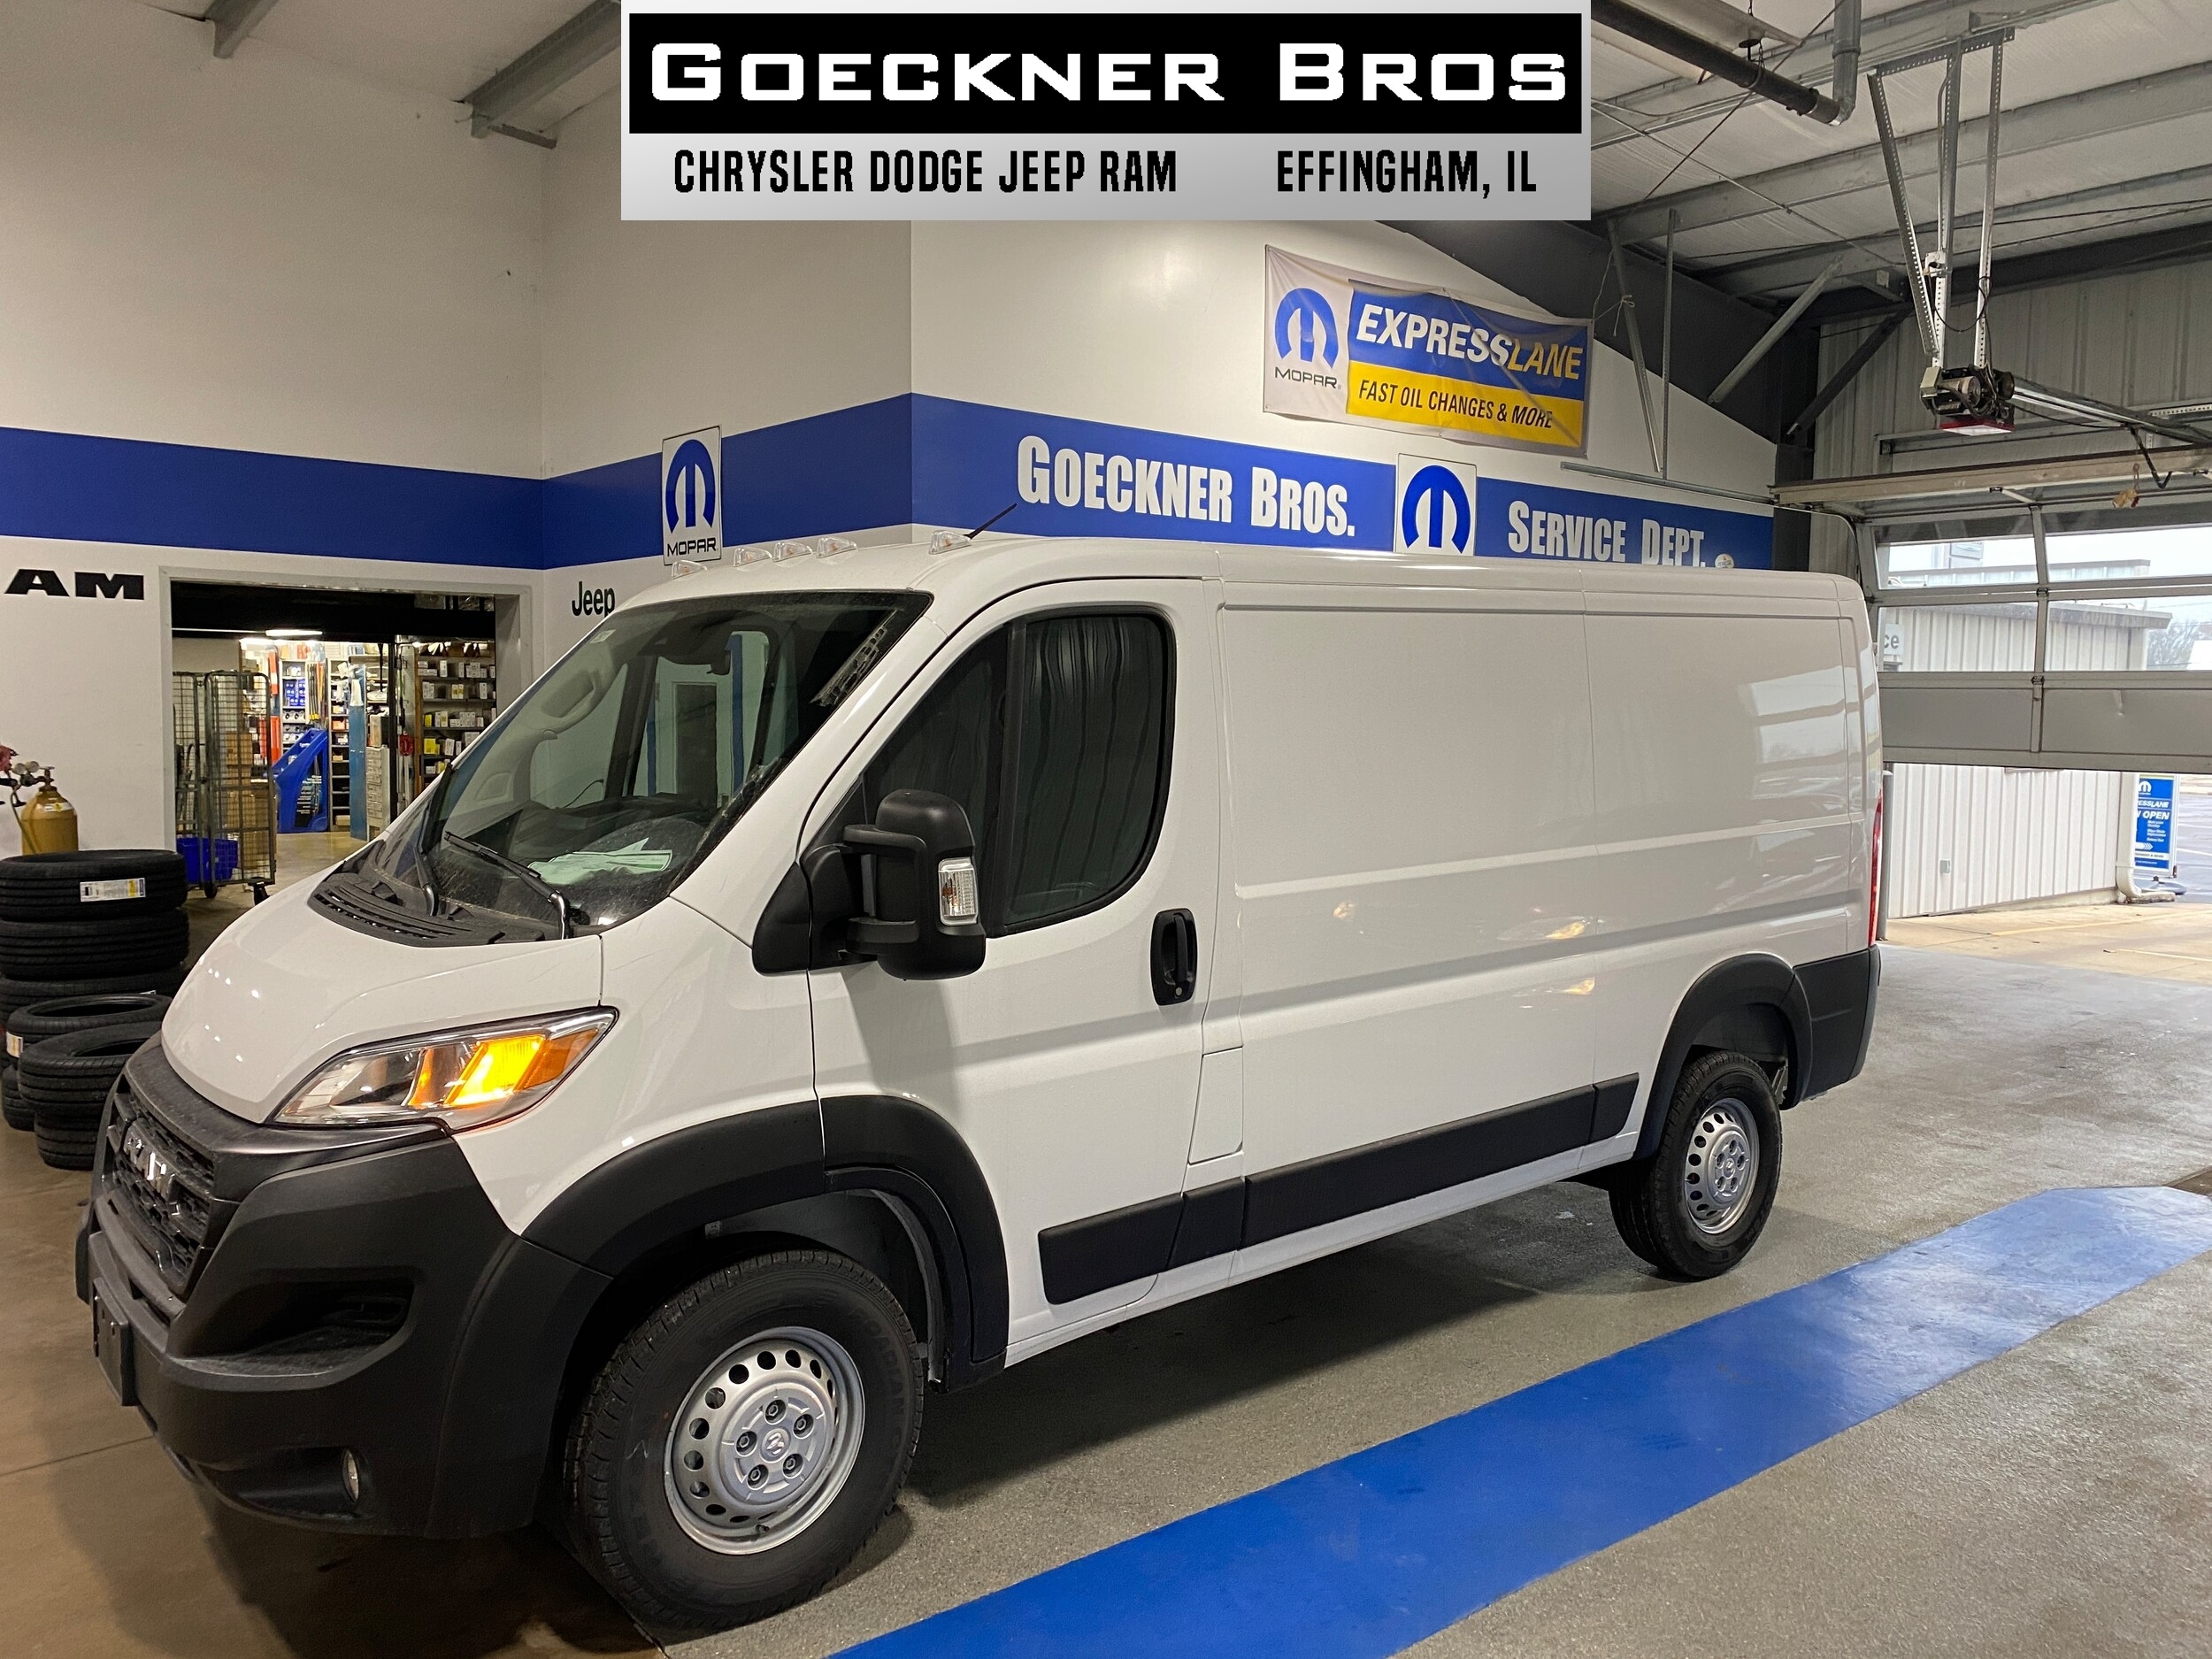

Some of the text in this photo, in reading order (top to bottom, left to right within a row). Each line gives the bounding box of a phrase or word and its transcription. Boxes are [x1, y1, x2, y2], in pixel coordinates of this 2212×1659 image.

[1275, 366, 1338, 389] MOPAR
[1359, 380, 1554, 429] FAST OIL CHANGES & MORE
[1018, 435, 1356, 537] GOECKNER BROS.
[667, 537, 717, 557] MOPAR
[1508, 500, 1707, 567] SERVICE DEPT.
[572, 580, 616, 618] Jeep
[2142, 810, 2170, 820] OPEN
